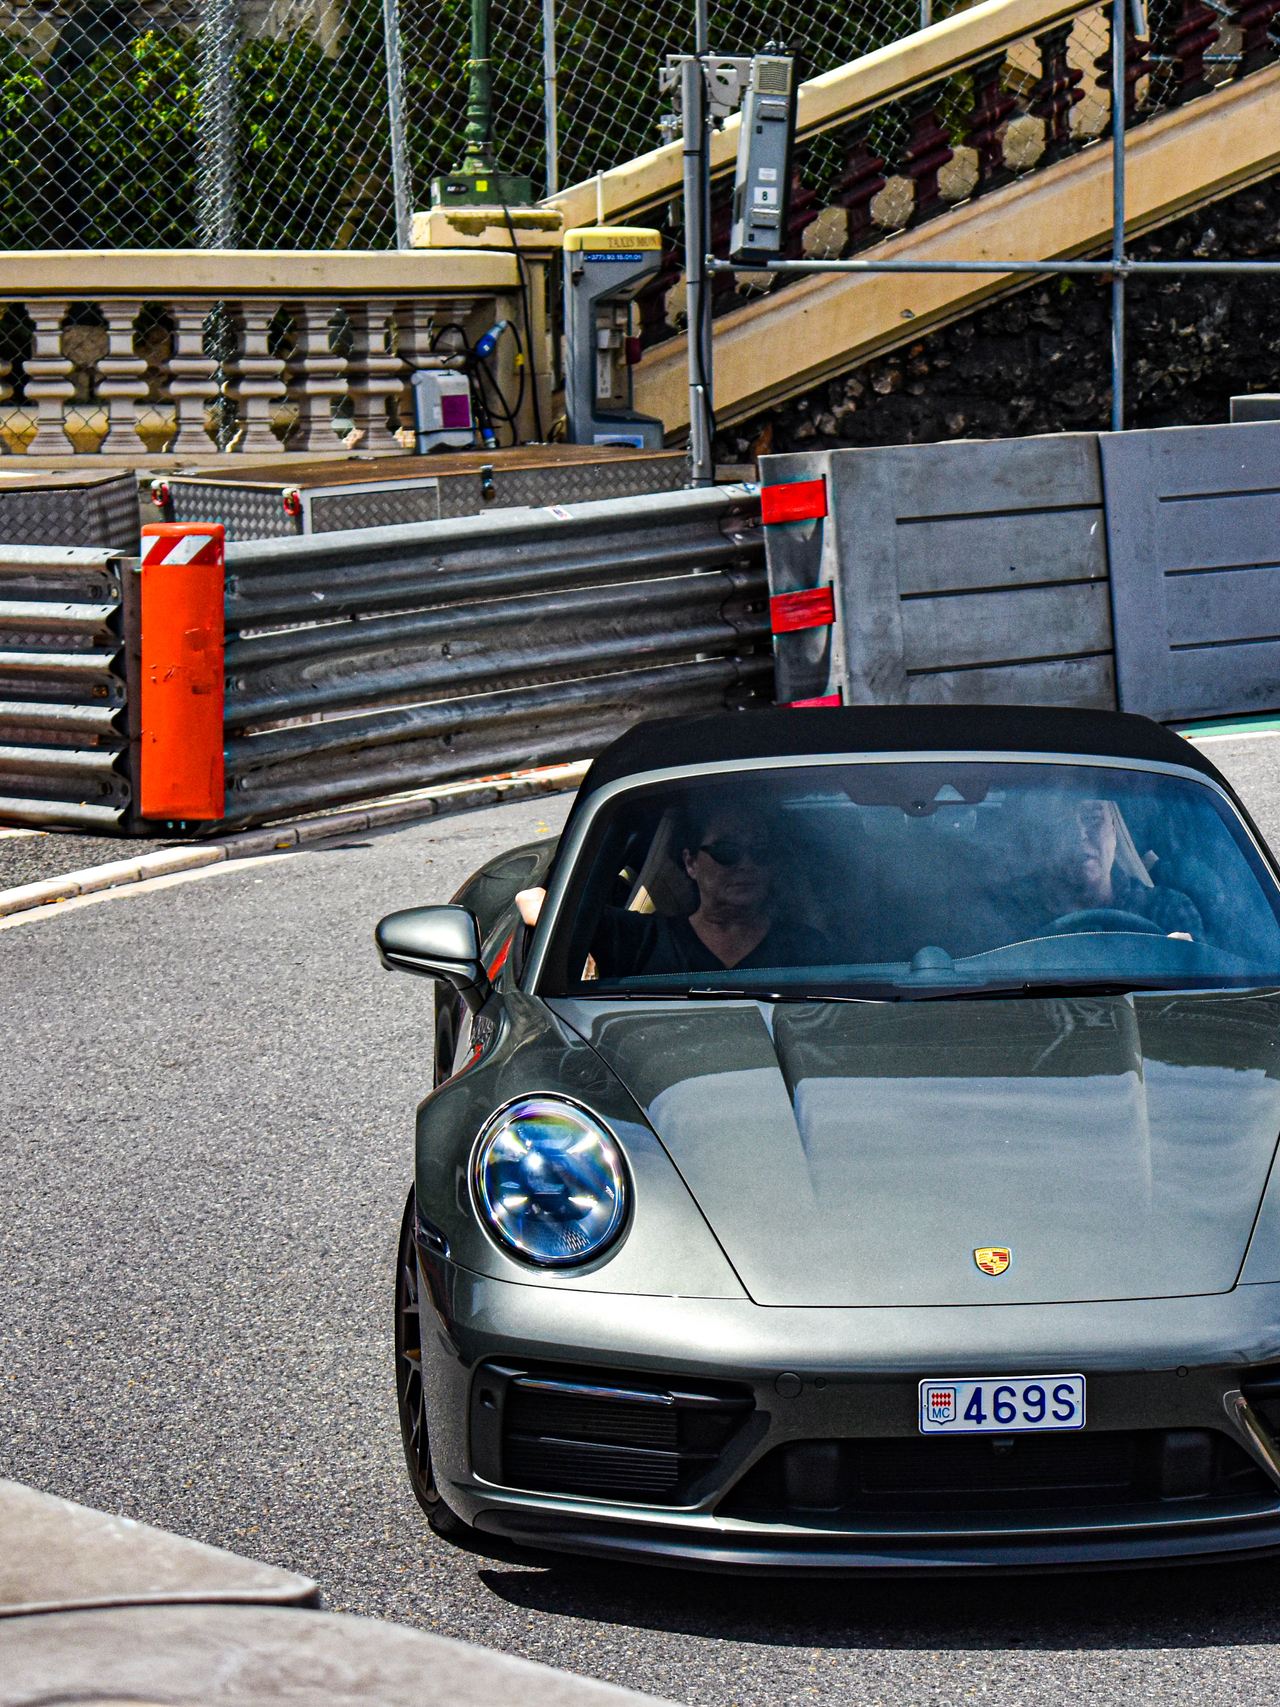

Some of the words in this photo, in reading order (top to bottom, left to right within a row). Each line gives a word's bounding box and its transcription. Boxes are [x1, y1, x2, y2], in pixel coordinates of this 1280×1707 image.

[762, 190, 768, 201] 8
[607, 236, 635, 248] TAXIS
[932, 1407, 950, 1419] MC
[964, 1384, 1075, 1424] 469S
